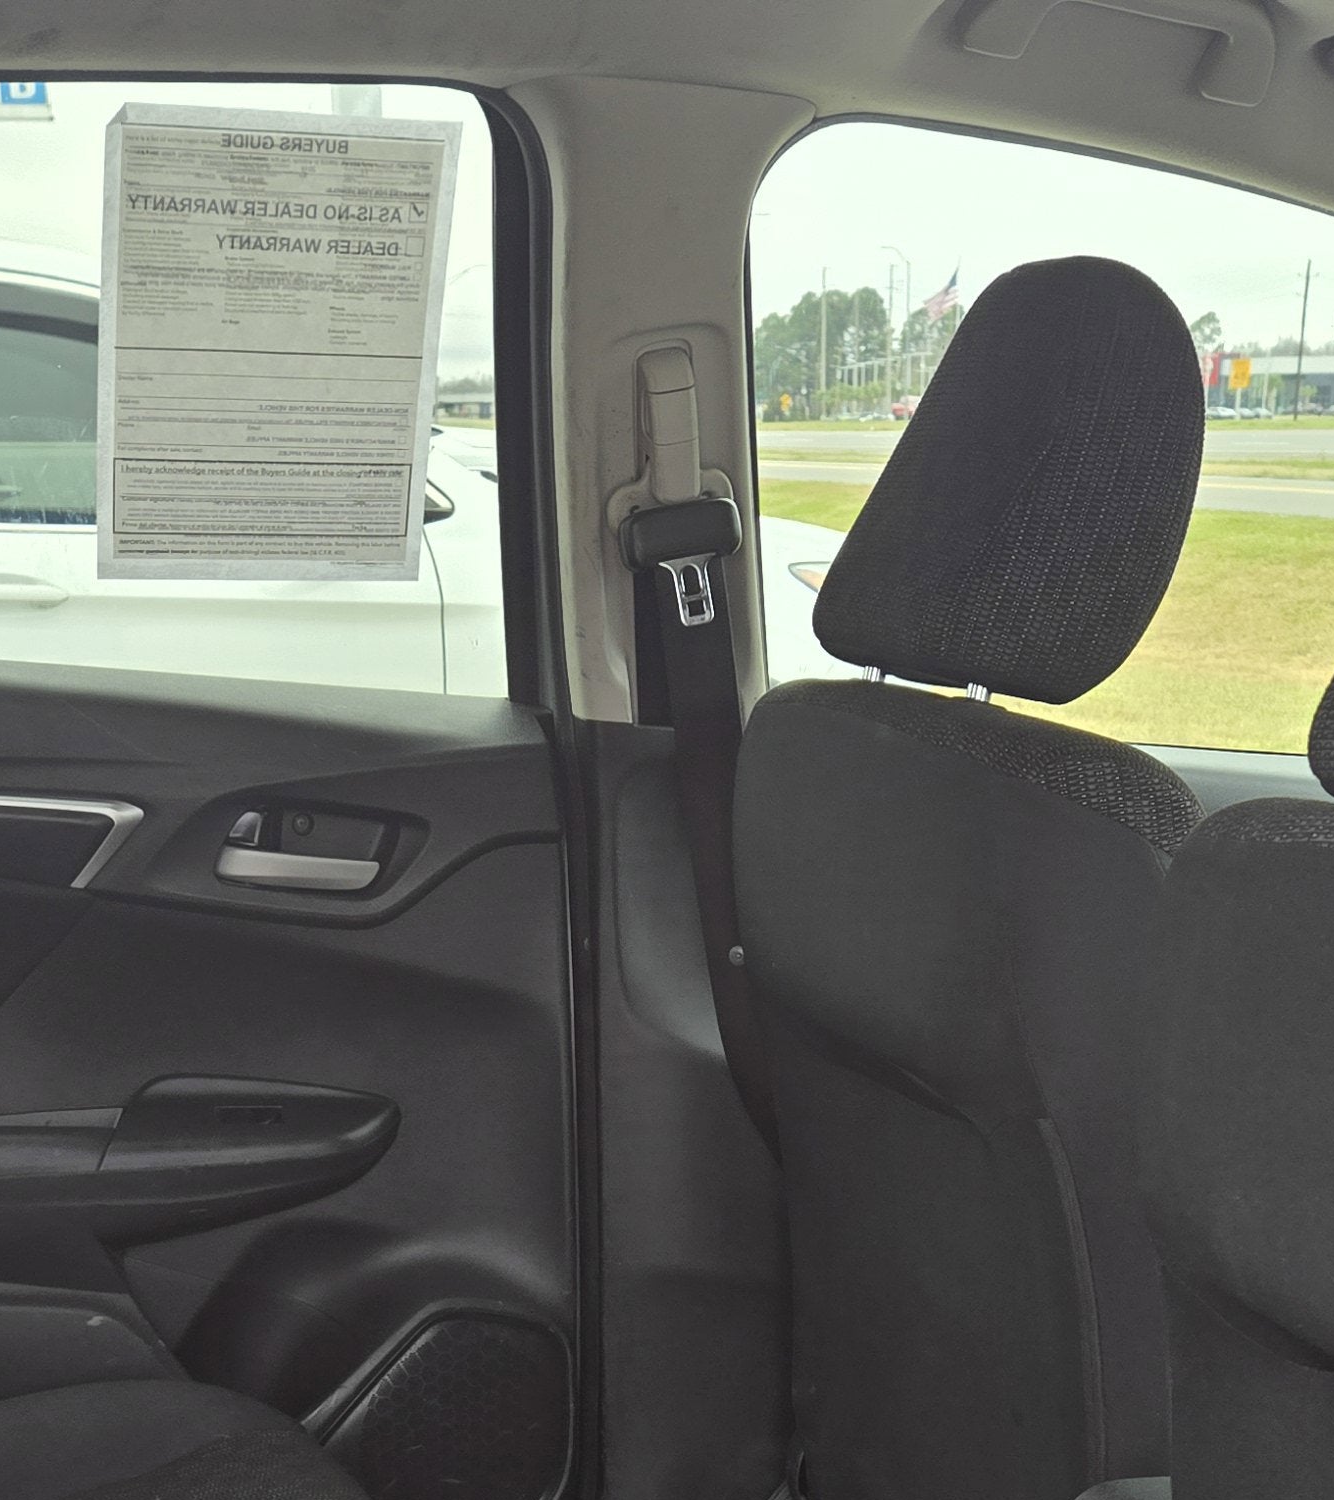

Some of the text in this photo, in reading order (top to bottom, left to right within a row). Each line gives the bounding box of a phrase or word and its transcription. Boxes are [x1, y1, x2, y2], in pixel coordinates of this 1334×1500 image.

[155, 465, 206, 475] acknowledge
[208, 466, 235, 476] receipt
[237, 466, 245, 475] of
[246, 467, 259, 475] the
[261, 467, 286, 477] Buyers
[288, 468, 311, 477] Guide
[322, 468, 334, 477] the
